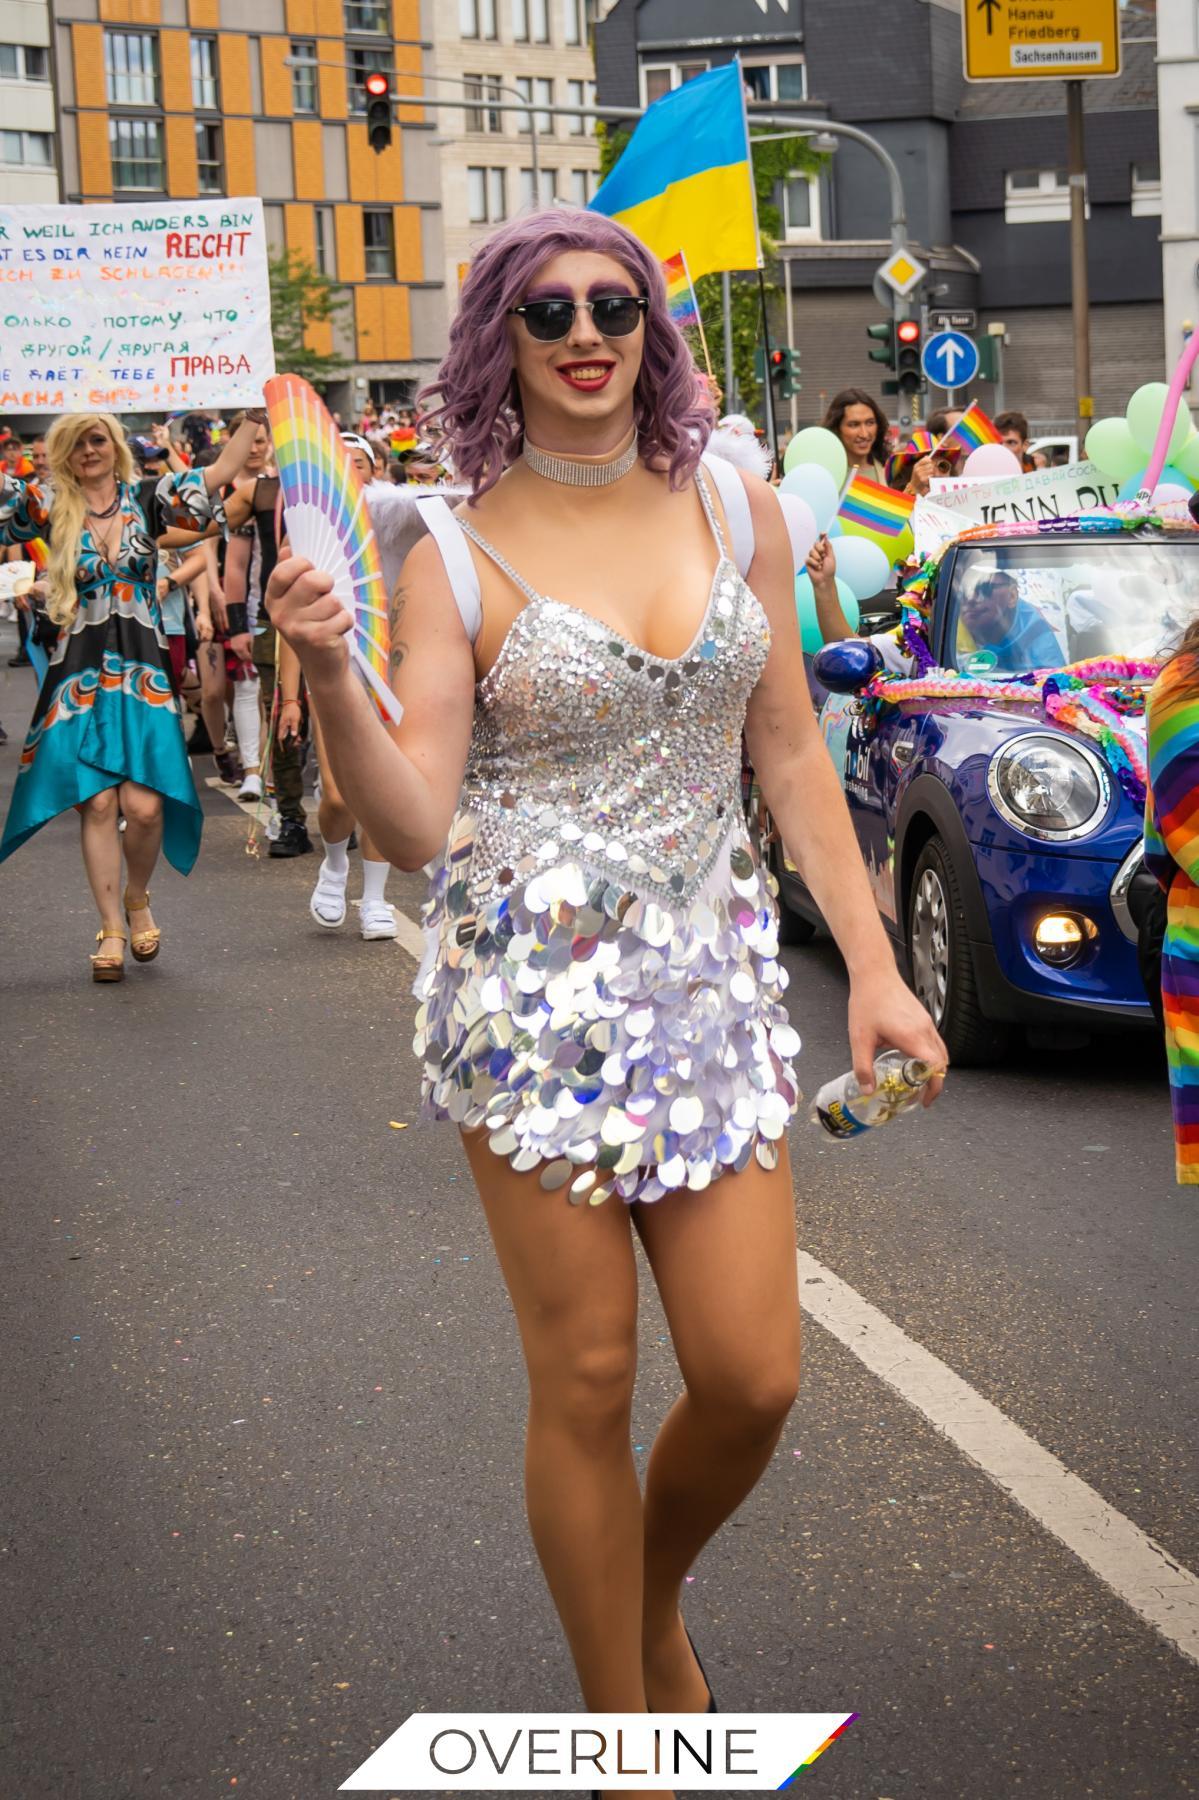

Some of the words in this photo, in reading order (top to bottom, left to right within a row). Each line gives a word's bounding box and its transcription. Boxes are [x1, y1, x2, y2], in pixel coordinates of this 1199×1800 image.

[1008, 8, 1054, 20] Hanau
[1008, 25, 1080, 41] Friedberg
[1015, 47, 1097, 63] Sachsenhausen
[23, 224, 75, 239] WEIL
[89, 222, 124, 236] ICH
[131, 214, 209, 233] ANDERS
[220, 213, 253, 228] BIN
[23, 248, 46, 261] ES
[53, 247, 91, 261] DIR
[104, 246, 148, 260] KEIN
[166, 231, 252, 259] RECHT
[110, 368, 156, 381] ТЕБЕ
[170, 354, 251, 378] ПРАВА
